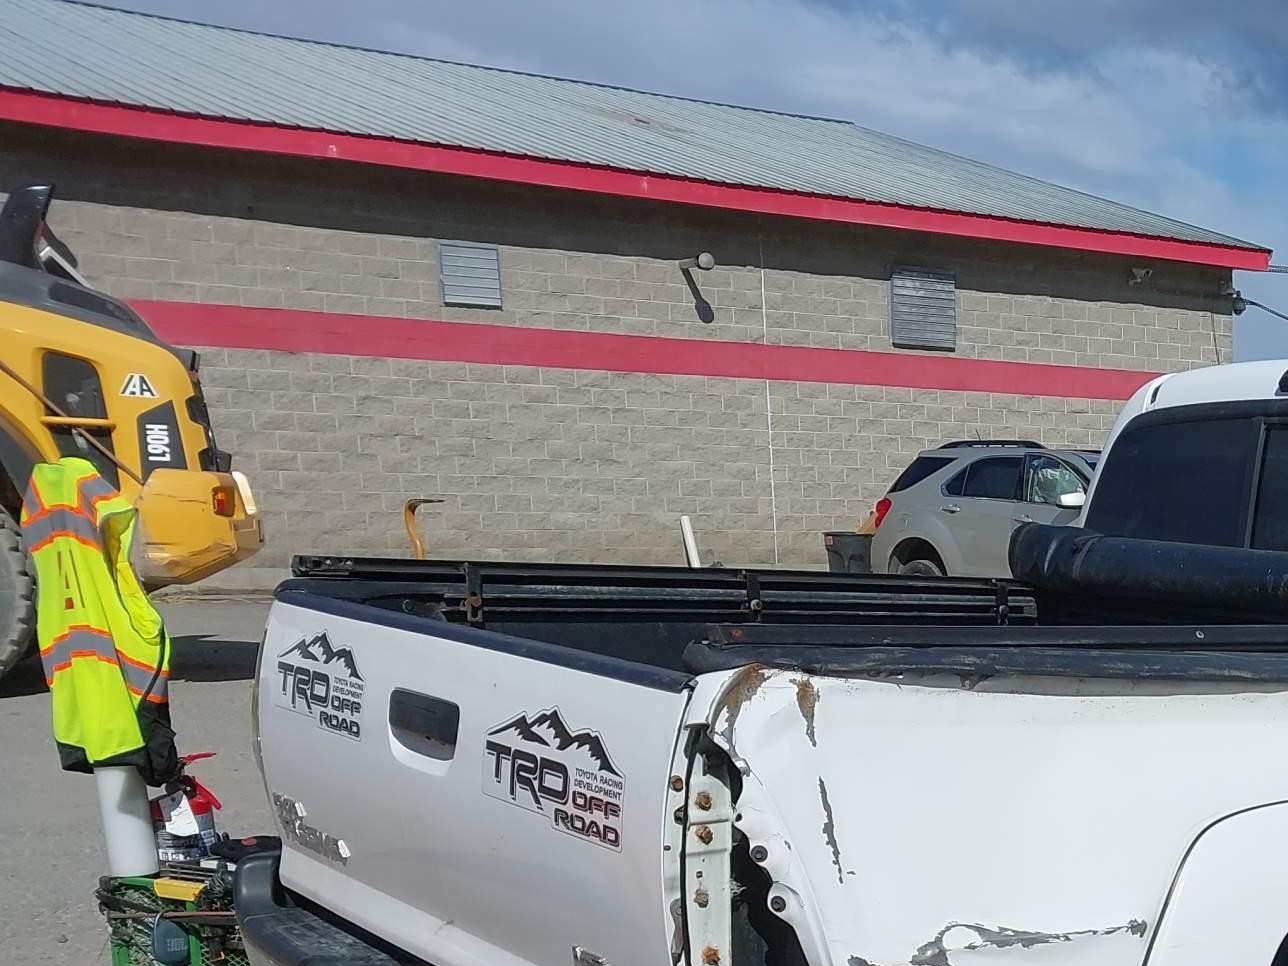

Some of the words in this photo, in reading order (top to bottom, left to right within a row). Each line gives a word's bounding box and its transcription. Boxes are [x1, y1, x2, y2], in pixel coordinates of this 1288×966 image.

[145, 424, 171, 462] L90H
[277, 660, 330, 714] TRD
[331, 694, 362, 716] OFF
[319, 711, 361, 738] ROAD
[485, 739, 570, 811] TRD
[574, 778, 623, 801] DEVELOPMENT
[575, 767, 598, 783] TOYOTA
[599, 775, 623, 791] RACING
[572, 790, 621, 820] OFF
[554, 807, 620, 848] ROAD
